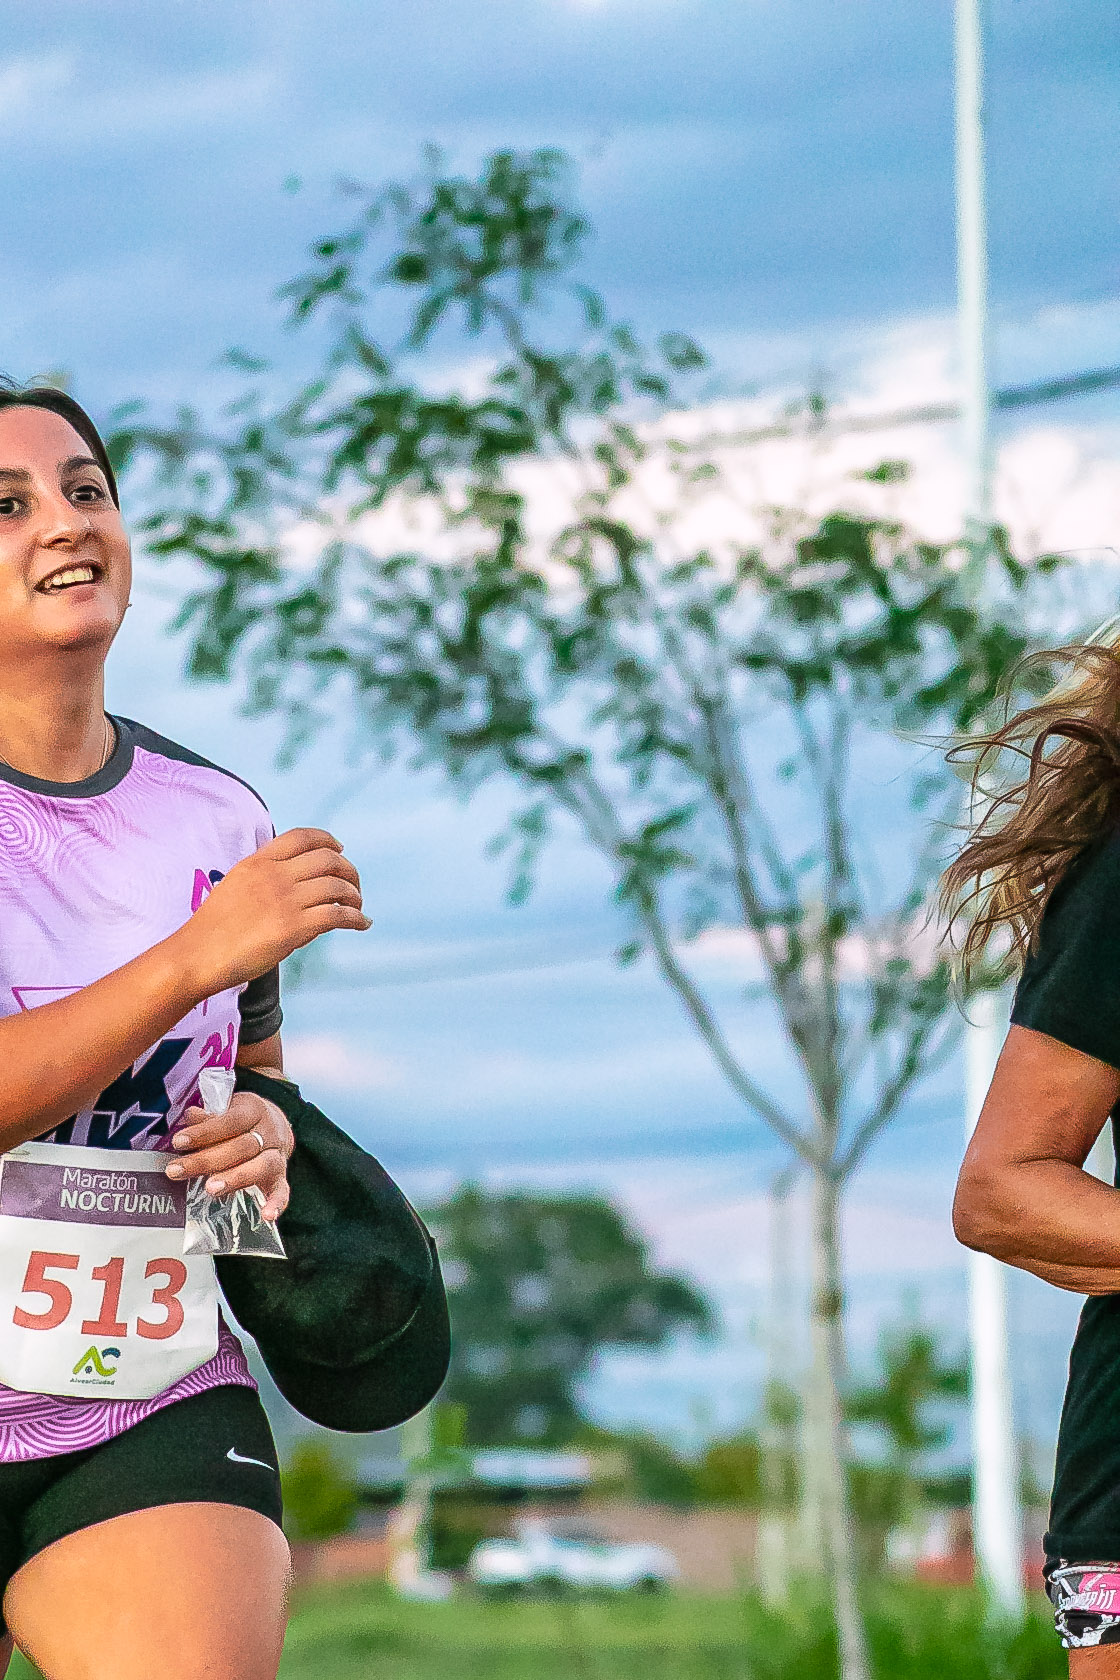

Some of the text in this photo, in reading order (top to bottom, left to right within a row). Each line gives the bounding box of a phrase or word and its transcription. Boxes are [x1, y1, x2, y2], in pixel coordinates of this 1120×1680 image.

[62, 1167, 138, 1191] Maratón
[60, 1188, 177, 1214] NOCTURNA
[12, 1250, 188, 1340] 513
